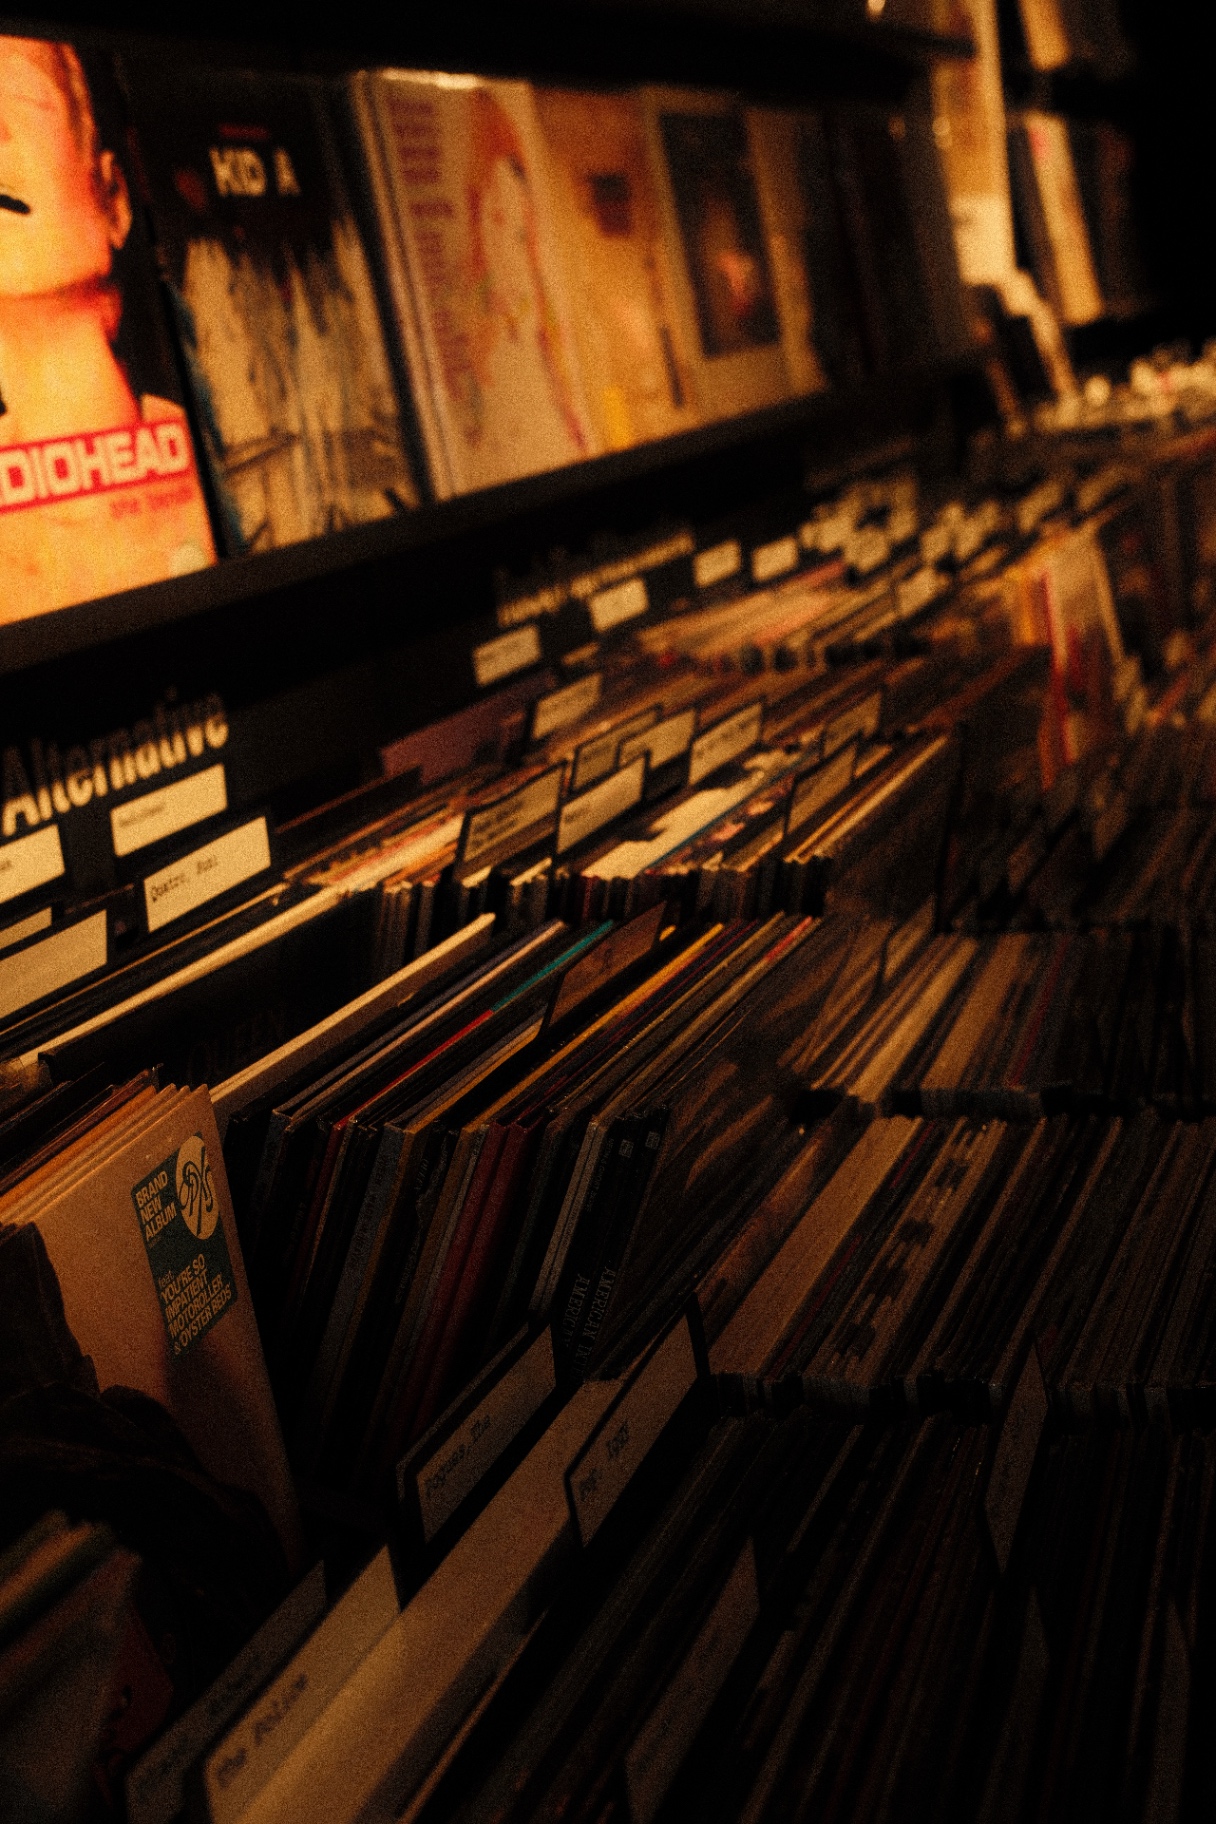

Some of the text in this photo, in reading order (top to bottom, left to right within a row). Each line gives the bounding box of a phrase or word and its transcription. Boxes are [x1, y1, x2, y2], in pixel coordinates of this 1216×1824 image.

[209, 146, 301, 198] KID A
[2, 685, 230, 837] Alternative
[135, 1170, 169, 1208] BRAND
[140, 1195, 163, 1225] NEW
[145, 1201, 178, 1242] ALBUM
[192, 1253, 205, 1275] SO
[581, 1264, 617, 1341] AMERICAN
